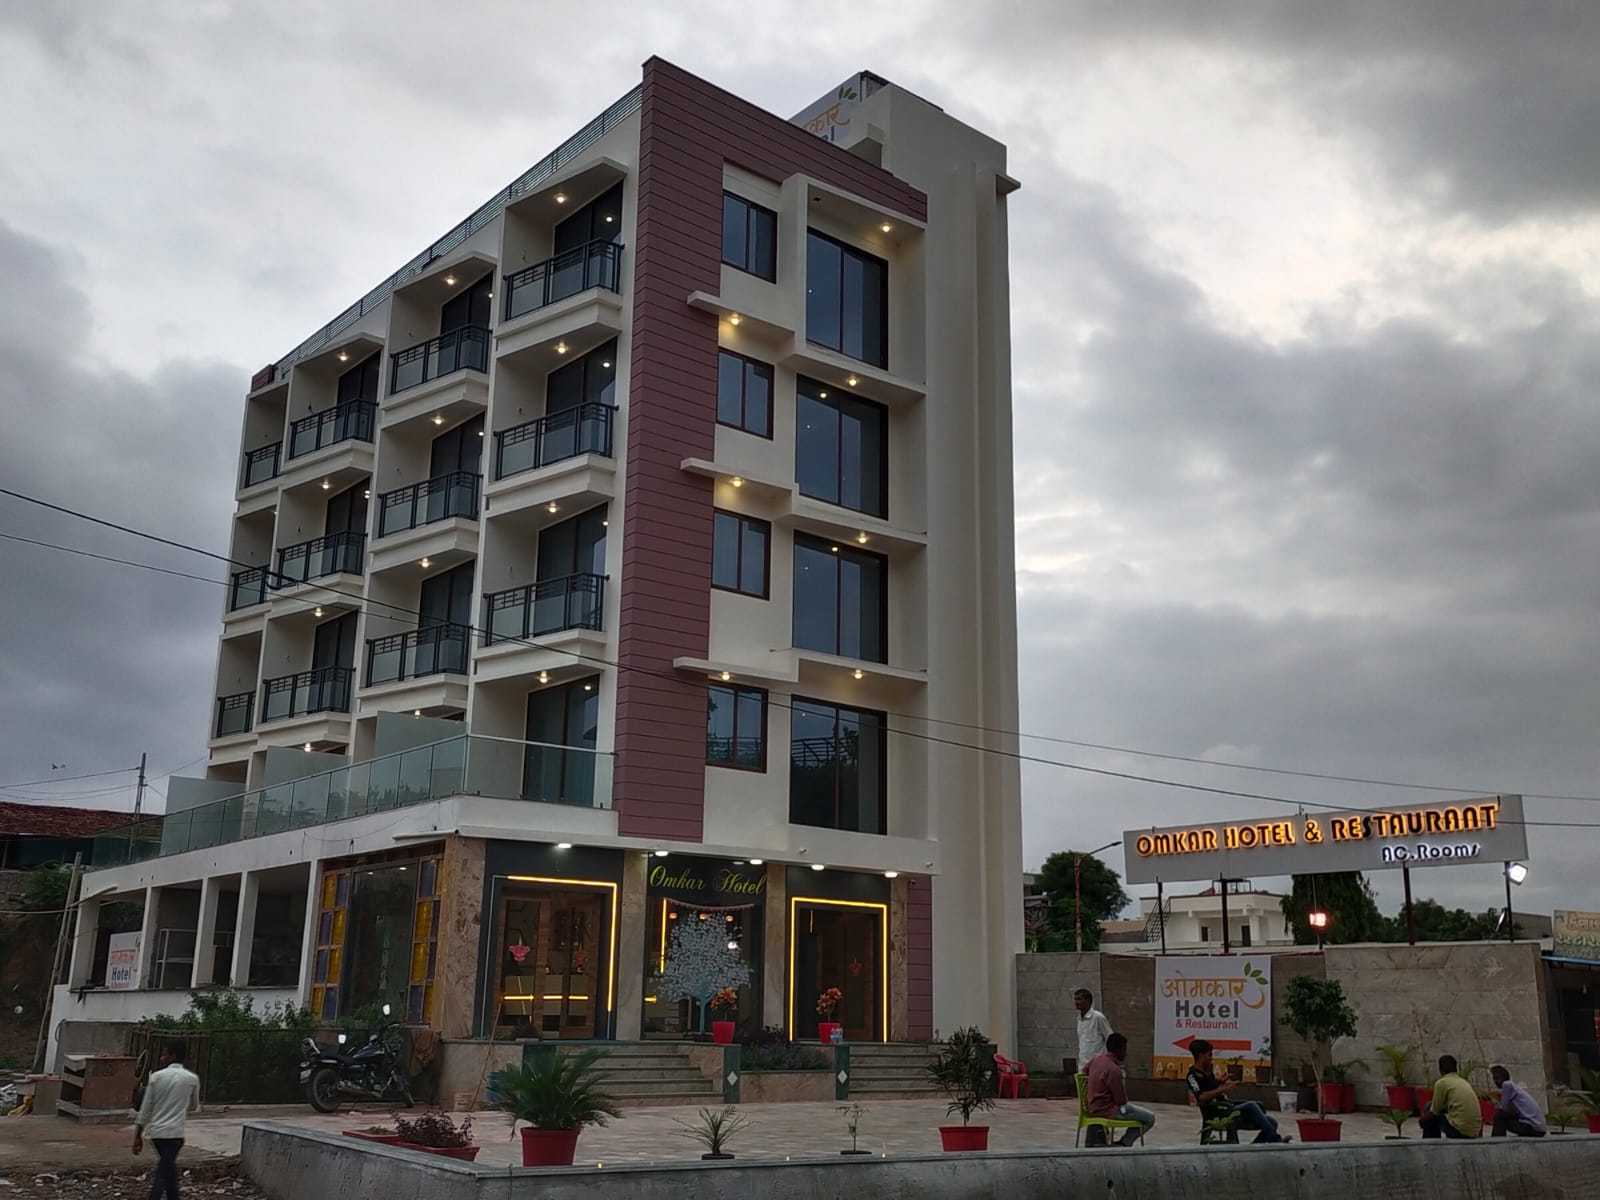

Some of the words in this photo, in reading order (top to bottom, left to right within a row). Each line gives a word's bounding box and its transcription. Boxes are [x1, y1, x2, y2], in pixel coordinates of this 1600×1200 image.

[1136, 828, 1218, 857] OMKAR
[1223, 821, 1296, 849] HOTEL
[1303, 819, 1323, 844] &
[1331, 803, 1498, 841] RESTAURANT
[649, 865, 705, 890] Omkar
[712, 868, 768, 895] Hotel
[1160, 970, 1265, 1009] ओमकार
[1175, 1000, 1239, 1018] Hotel
[1175, 1019, 1182, 1028] &
[1185, 1019, 1238, 1030] Restaurant
